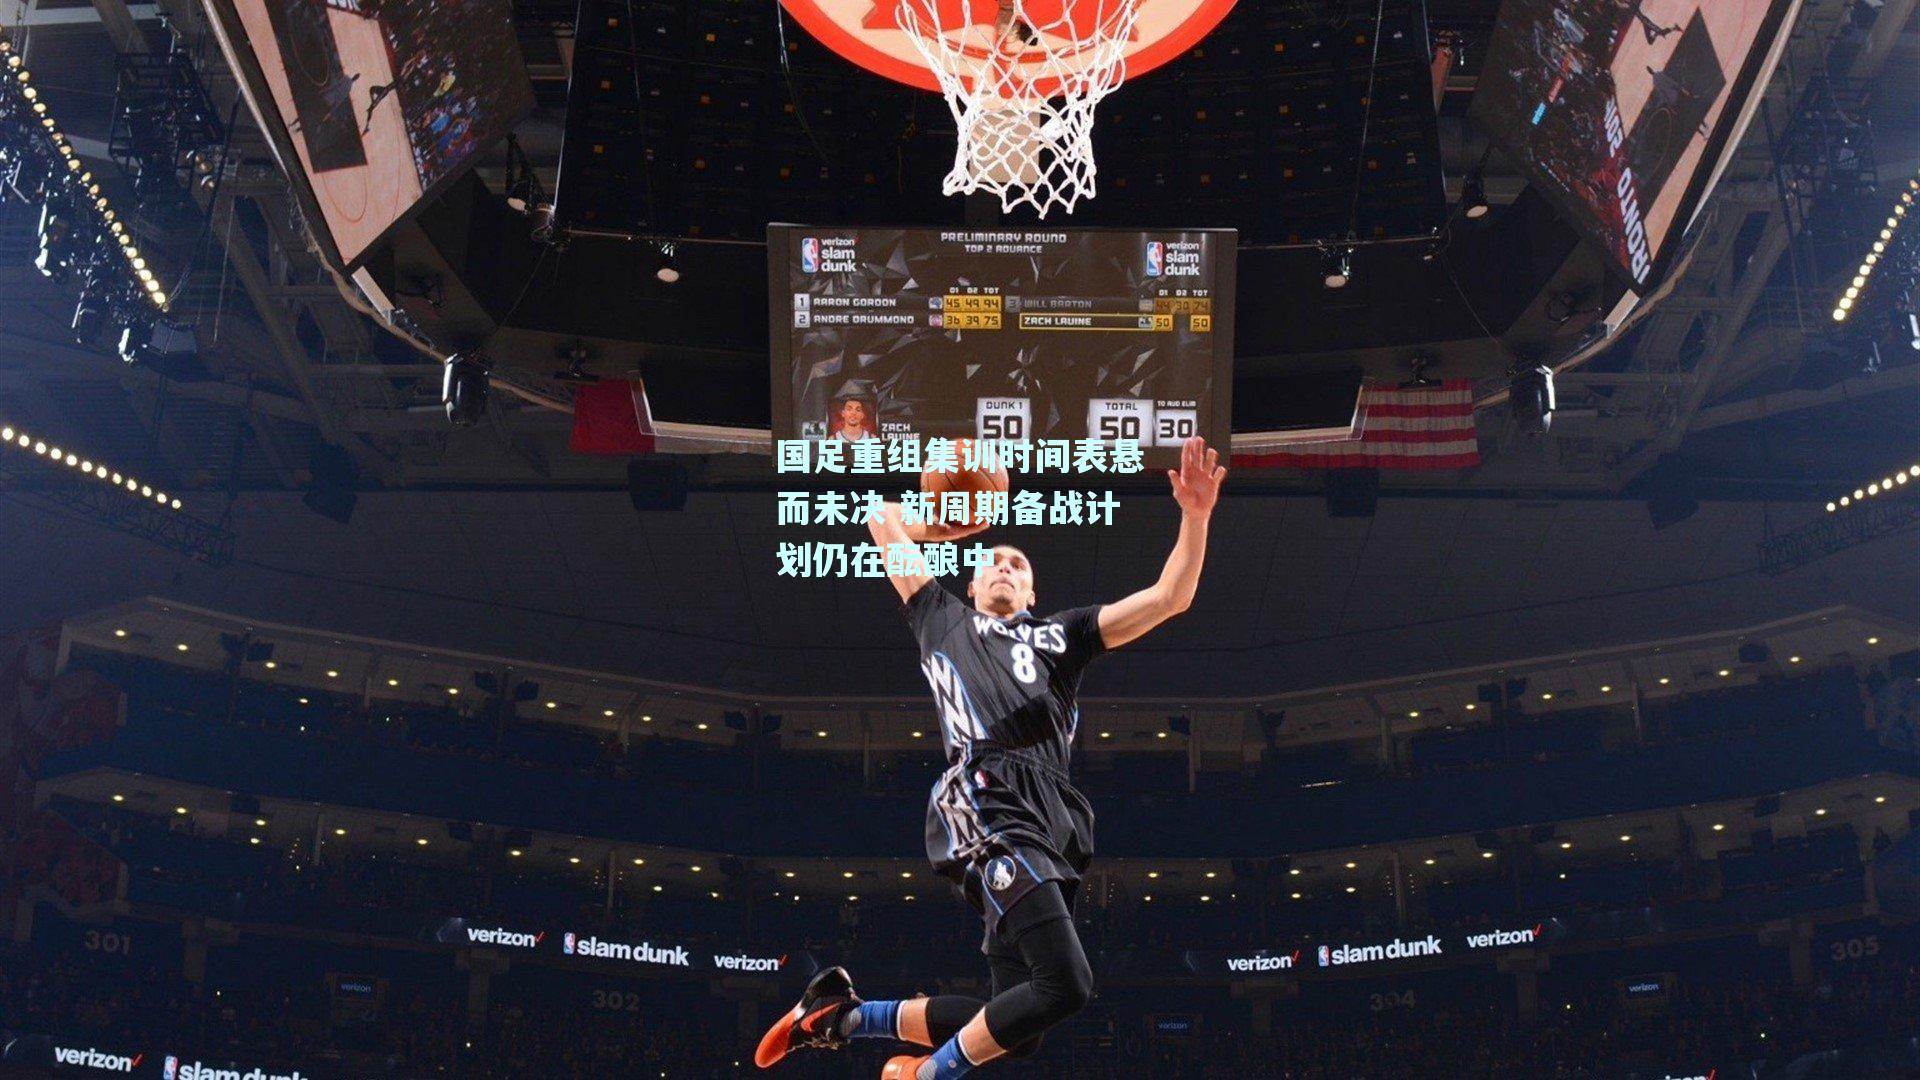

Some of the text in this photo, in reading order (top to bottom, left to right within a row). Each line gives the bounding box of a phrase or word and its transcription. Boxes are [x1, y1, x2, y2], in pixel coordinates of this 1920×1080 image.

[821, 237, 855, 246] verizon
[941, 232, 1067, 243] PRELIMINARY ROUND
[965, 245, 1043, 253] TOP 2 ADVANCE
[1165, 242, 1199, 250] verizon
[821, 246, 856, 260] slam
[1165, 250, 1199, 263] slam
[821, 260, 857, 272] dunk
[1165, 263, 1200, 276] dunk
[813, 298, 850, 306] AARON
[853, 298, 897, 307] GORDON
[947, 299, 960, 308] 45
[966, 299, 979, 308] 49
[984, 299, 999, 308] 94
[1025, 299, 1047, 308] WILL
[1050, 299, 1092, 308] BARTON
[799, 315, 806, 324] 2
[813, 315, 850, 324] ANDRE
[852, 315, 914, 324] DRUMMOND
[966, 316, 979, 325] 39
[984, 316, 999, 325] 75
[1024, 317, 1208, 327] ZACH LAVINE 50 50
[986, 401, 1015, 410] DUNK
[1105, 402, 1138, 411] TOTAL
[881, 423, 911, 432] ZACH
[982, 415, 1023, 440] 50
[1100, 416, 1140, 440] 50
[1159, 418, 1193, 438] 30
[1011, 643, 1037, 683] 8
[468, 927, 536, 947] verizon
[1467, 928, 1534, 949] verizon
[577, 936, 689, 966] slam dunk
[1331, 935, 1442, 966] slam dunk
[1831, 935, 1880, 961] 305
[714, 954, 779, 971] verizon
[1227, 954, 1292, 972] verizon
[341, 982, 372, 993] verizon
[1629, 982, 1660, 993] verizon
[55, 1047, 132, 1072] verizon
